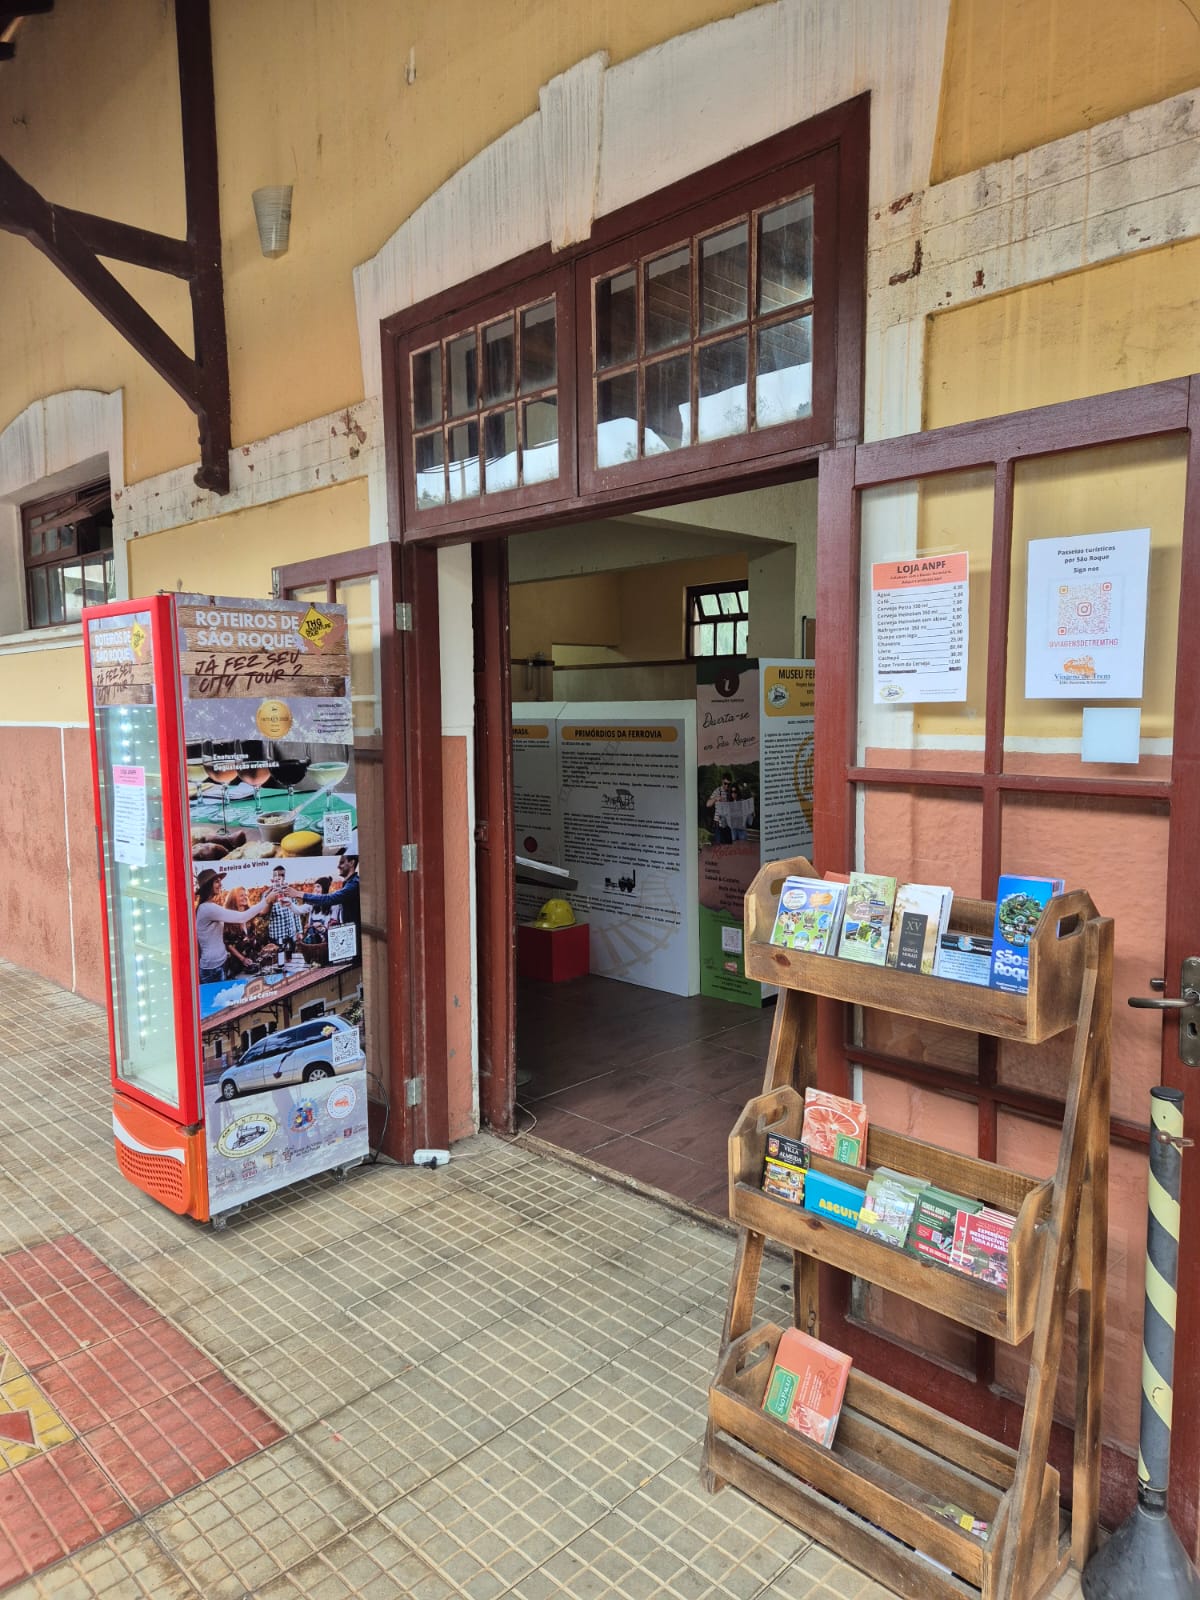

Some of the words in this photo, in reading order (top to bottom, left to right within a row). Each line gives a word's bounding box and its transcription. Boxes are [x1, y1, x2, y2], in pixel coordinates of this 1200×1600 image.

[1085, 545, 1116, 553] turísticos
[896, 564, 920, 574] LOJA
[921, 560, 946, 571] ANPF
[195, 610, 277, 629] ROTEIROS
[280, 615, 299, 632] DE
[306, 618, 322, 629] THG
[94, 632, 122, 647] ROTEIROS
[197, 626, 234, 647] SÃO
[237, 632, 294, 651] ROQUE
[96, 647, 110, 663] SÃO
[111, 648, 132, 663] ROQUE
[195, 654, 219, 676] JÁ
[223, 654, 262, 676] FEZ
[263, 648, 300, 669] SEU
[778, 669, 804, 680] MUSEU
[1054, 673, 1080, 681] Viagens
[199, 673, 238, 695] CITY
[245, 668, 285, 691] TOUR
[574, 728, 616, 739] PRIMÓRDIOS
[616, 729, 627, 738] DA
[627, 729, 662, 739] FERROVIA
[213, 763, 250, 772] Degustação
[251, 860, 269, 868] Vinho
[906, 921, 922, 932] XV
[995, 949, 1023, 966] São
[993, 962, 1029, 982] Roqu
[784, 1145, 799, 1155] VILLA
